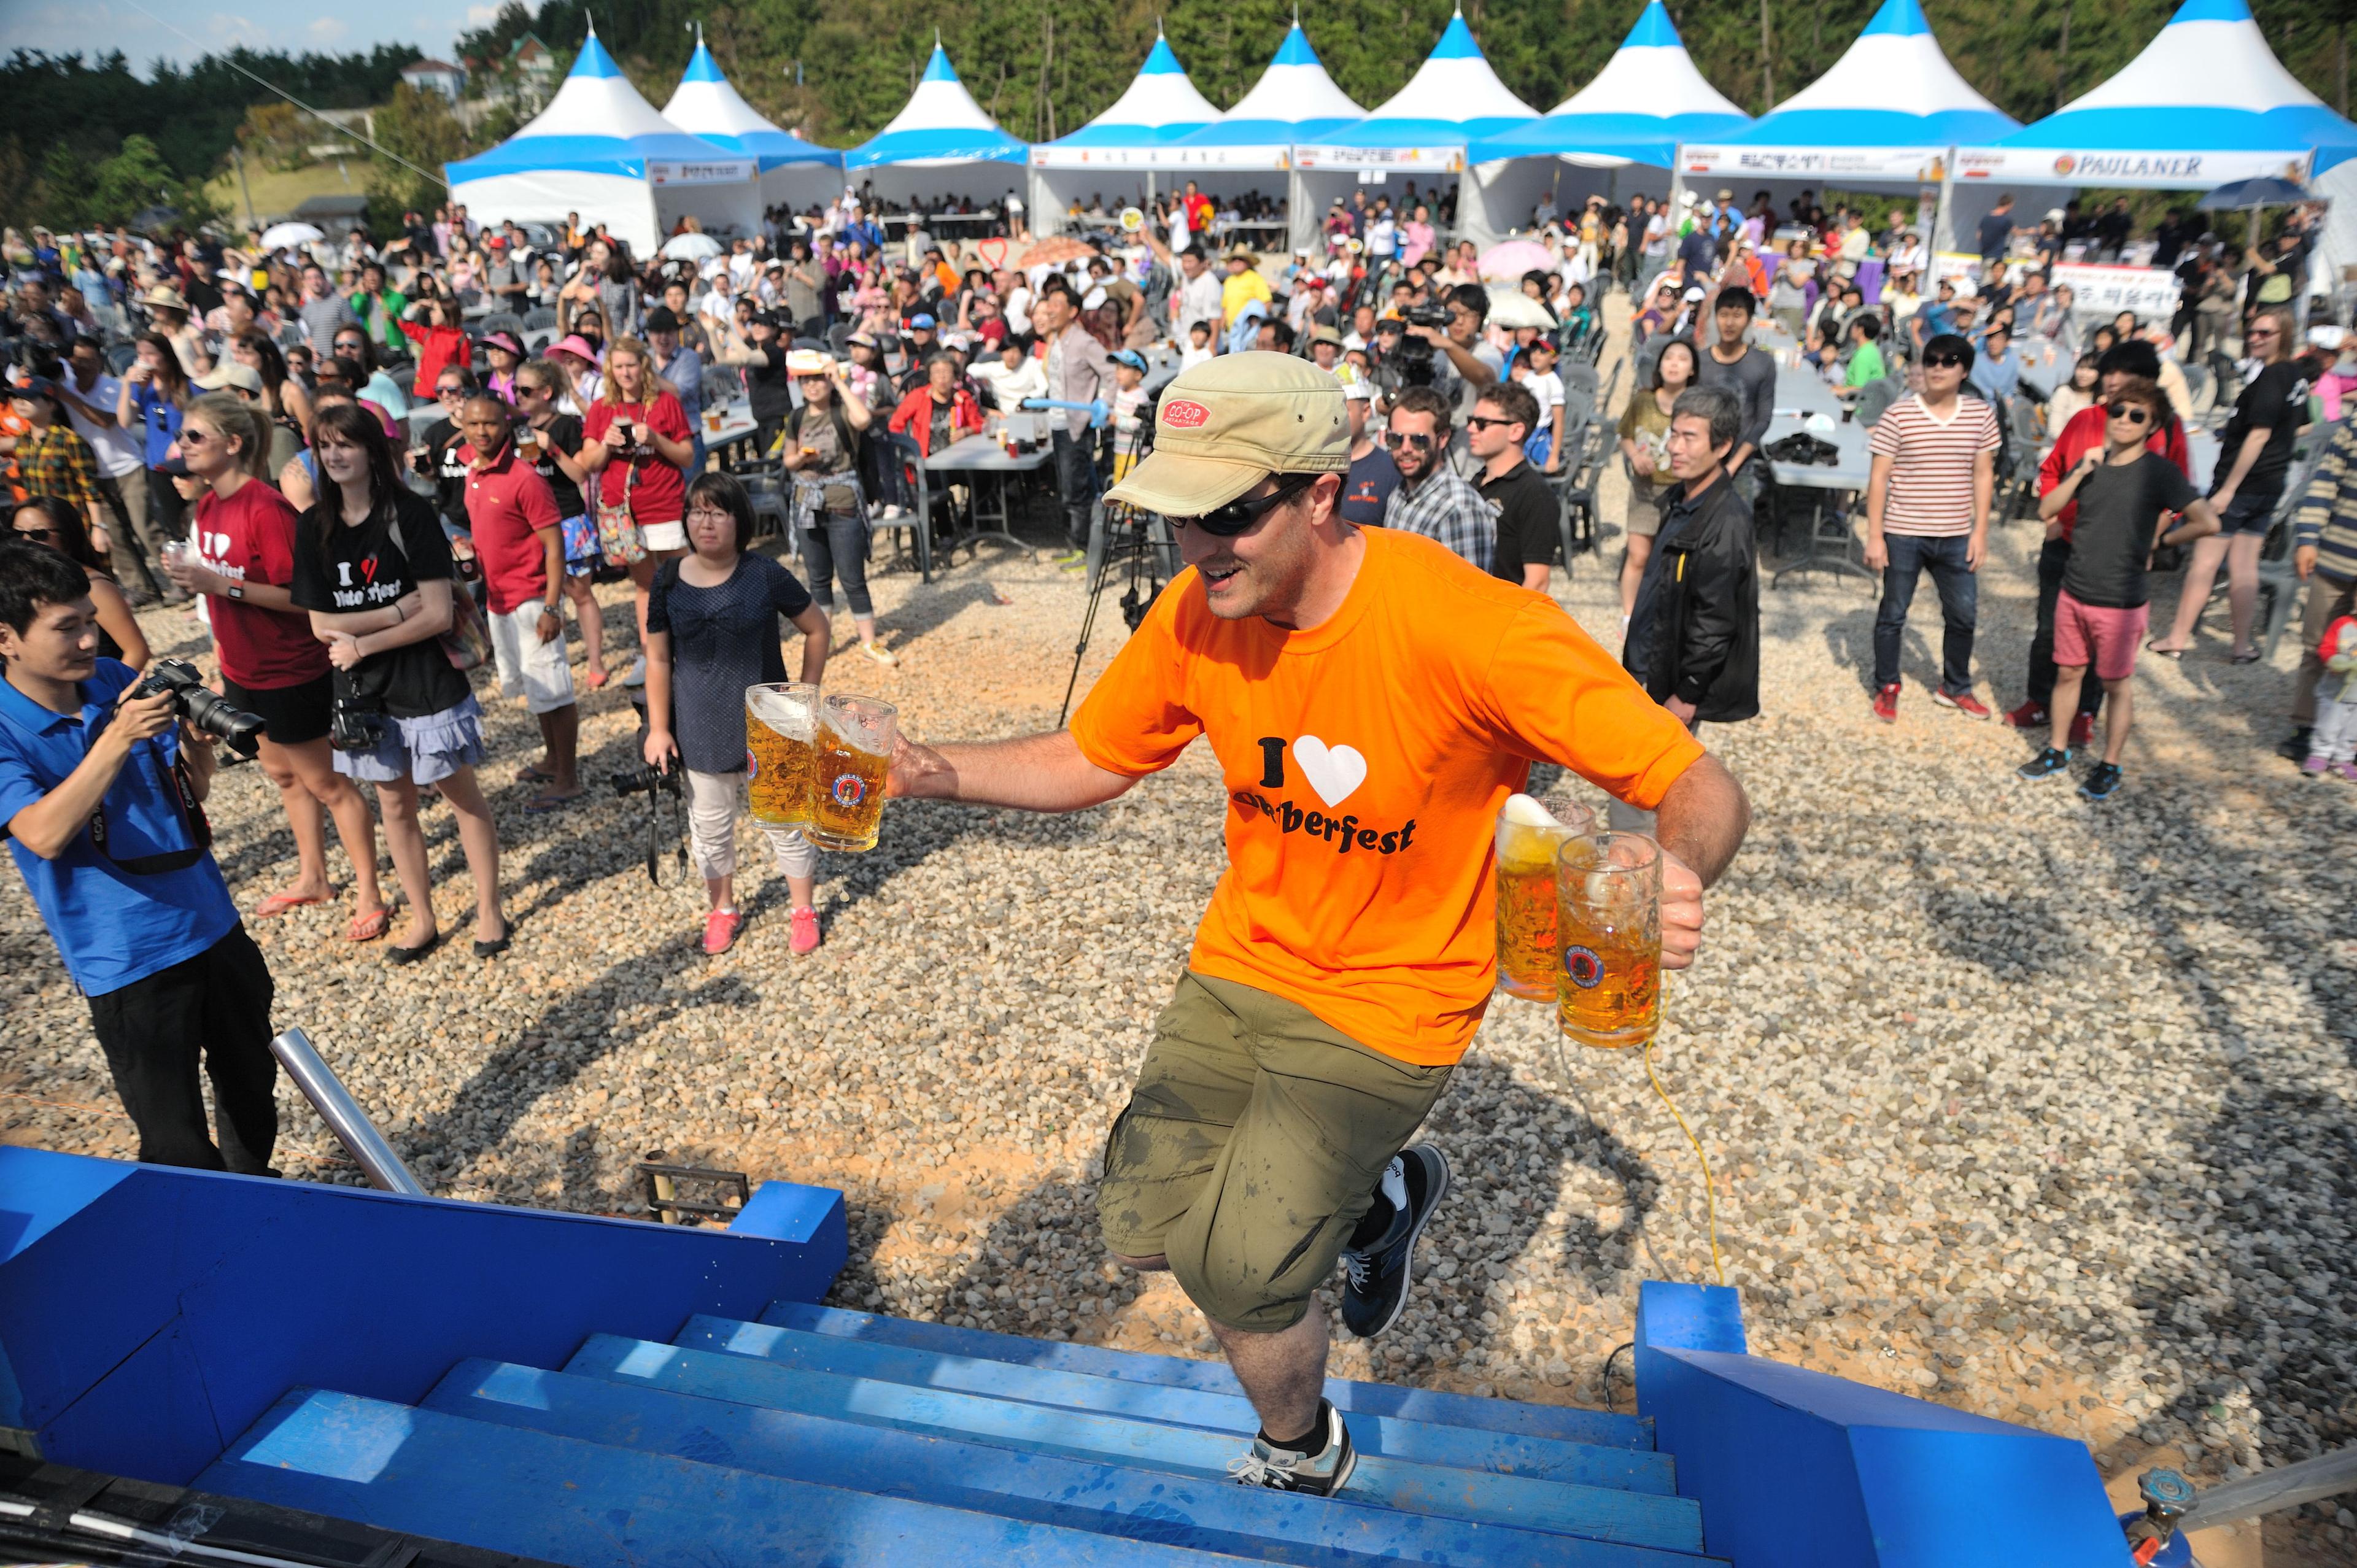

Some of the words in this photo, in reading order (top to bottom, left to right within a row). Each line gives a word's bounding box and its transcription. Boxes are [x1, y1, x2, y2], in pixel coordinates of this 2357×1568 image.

[2078, 155, 2202, 177] PAULANER
[1169, 405, 1201, 420] CO-OP
[203, 531, 213, 555] I
[337, 562, 354, 587] I
[1257, 736, 1288, 789] I
[835, 774, 865, 789] PAULANER
[1566, 946, 1602, 966] PAULANER
